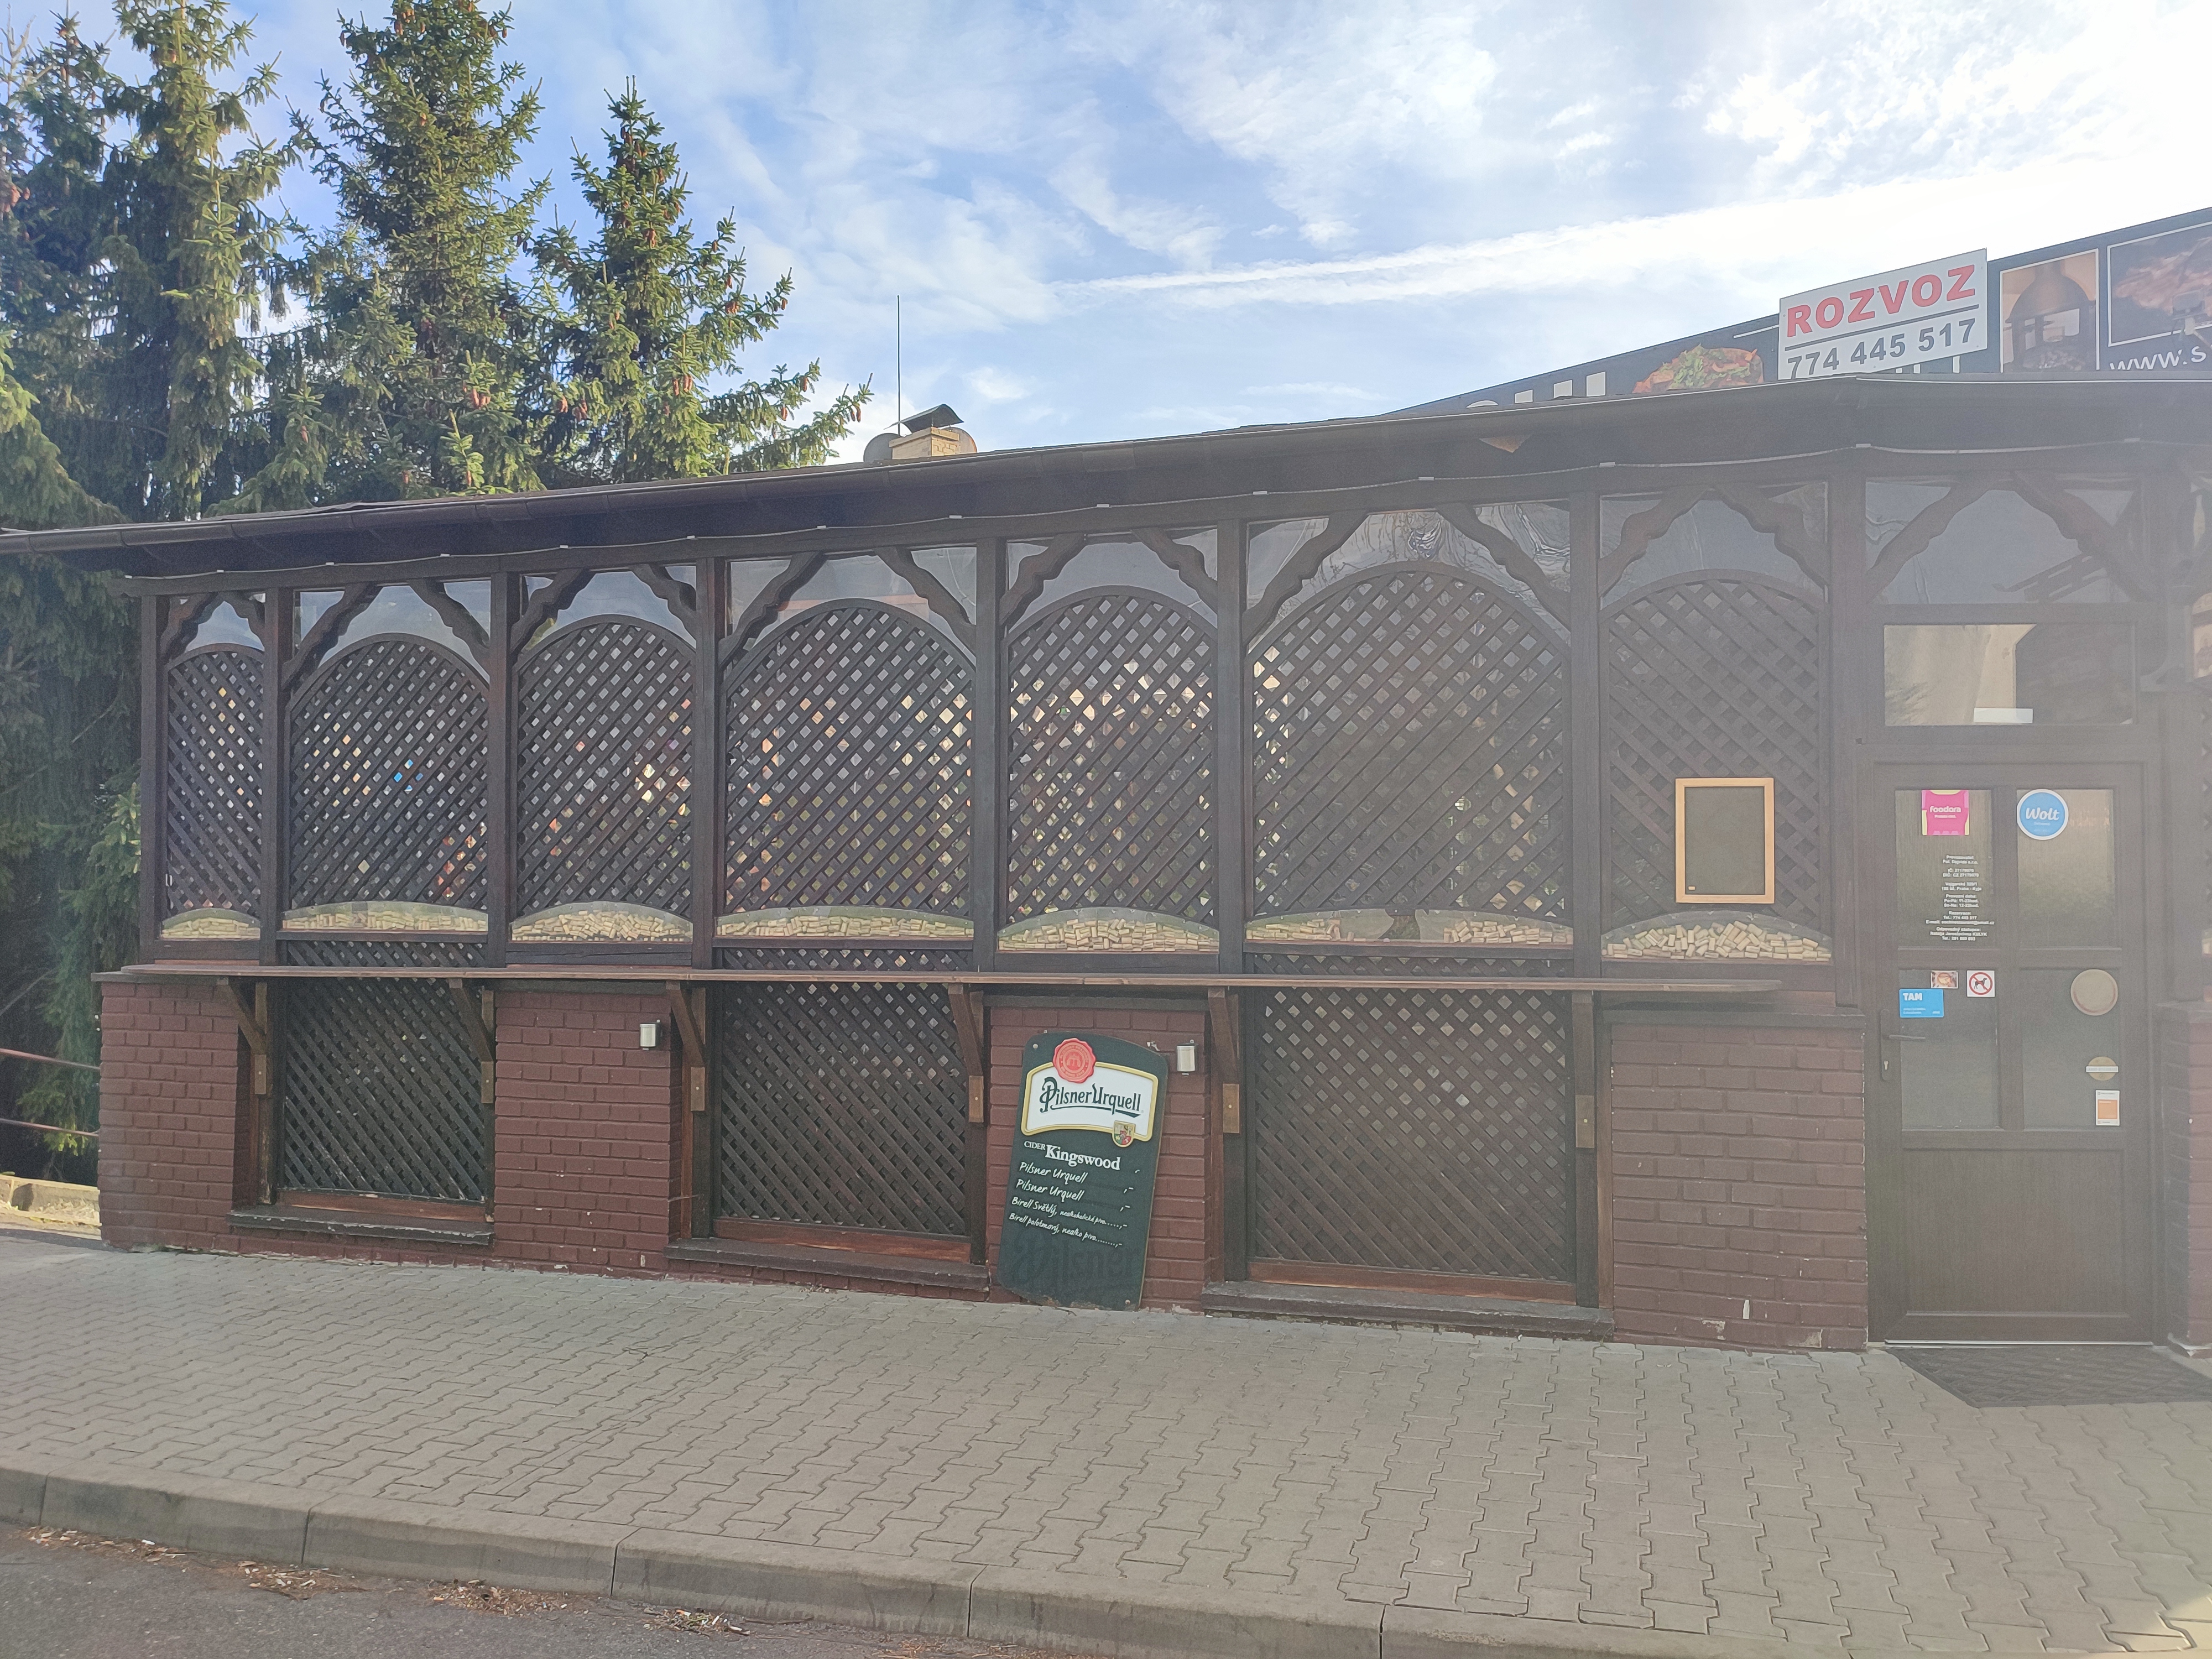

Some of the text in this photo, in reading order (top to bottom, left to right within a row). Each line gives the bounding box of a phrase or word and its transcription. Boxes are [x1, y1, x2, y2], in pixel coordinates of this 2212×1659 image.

[1787, 264, 1975, 337] ROZVOZ
[1788, 347, 1839, 379] 774
[1850, 333, 1906, 365] 445
[1918, 318, 1975, 352] 517
[2026, 807, 2060, 821] Wolt
[1902, 993, 1923, 1001] TAM
[1040, 1076, 1141, 1115] Pilsner Urquell
[1024, 1141, 1121, 1171] CIDER Kingswood
[1019, 1162, 1051, 1176] Pilsner
[1052, 1168, 1088, 1185] Urquell
[1015, 1179, 1048, 1193] Pilsner
[1049, 1186, 1085, 1202] Urquell
[1011, 1197, 1034, 1209] Birell
[1032, 1201, 1057, 1218] Světlý,
[1060, 1210, 1096, 1222] nealkoholické
[1009, 1213, 1029, 1223] Birell
[1025, 1218, 1060, 1235] polotmavý,
[1061, 1227, 1083, 1238] nealko
